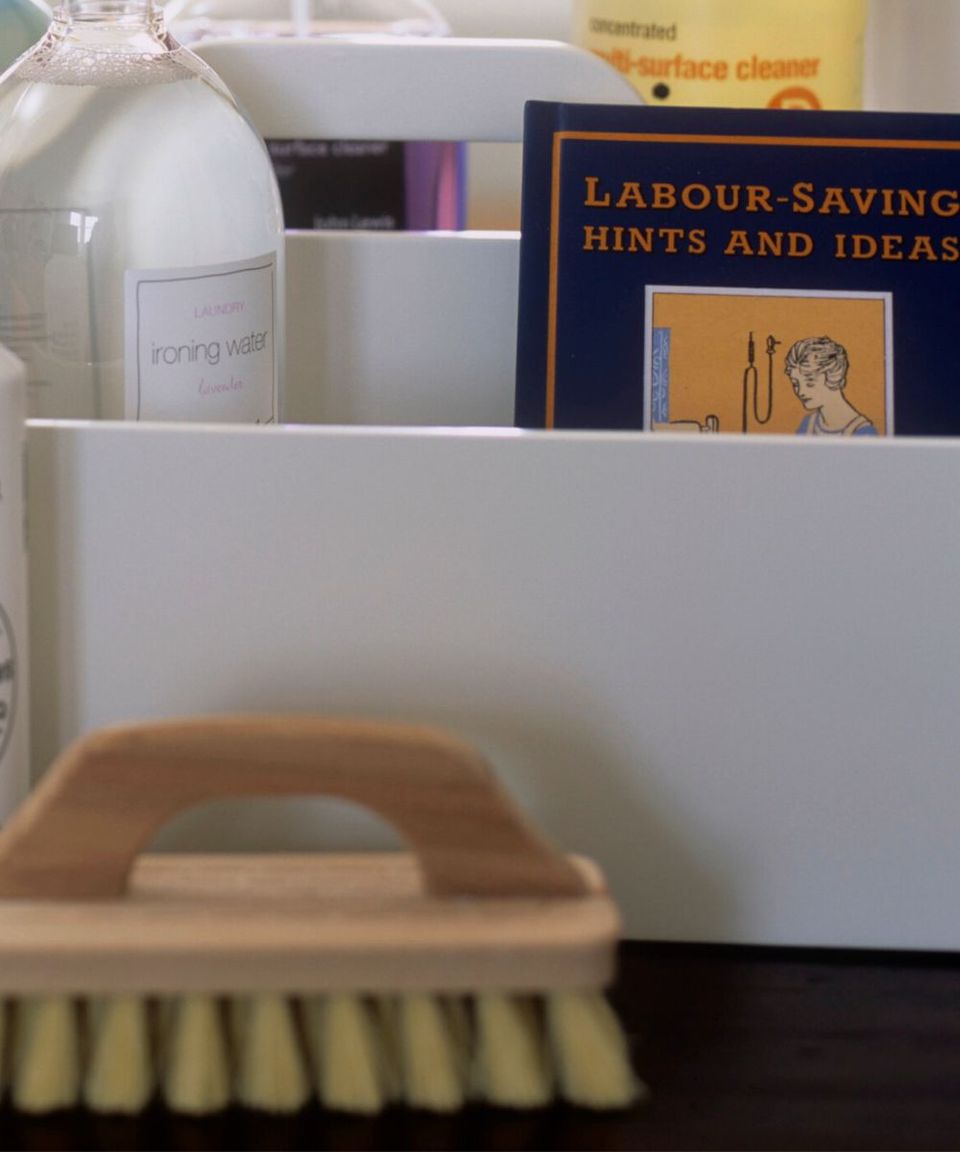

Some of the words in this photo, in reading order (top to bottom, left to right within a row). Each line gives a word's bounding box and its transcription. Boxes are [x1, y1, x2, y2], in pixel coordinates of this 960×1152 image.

[591, 48, 729, 81] lti-surface
[735, 55, 821, 81] cleaner
[583, 176, 960, 217] LABOUR-SAVING
[582, 225, 706, 254] HINTS
[724, 230, 814, 258] AND
[835, 234, 960, 261] IDEAS
[193, 299, 247, 319] LAUNDRY
[151, 338, 221, 366] ironing
[225, 329, 268, 357] water
